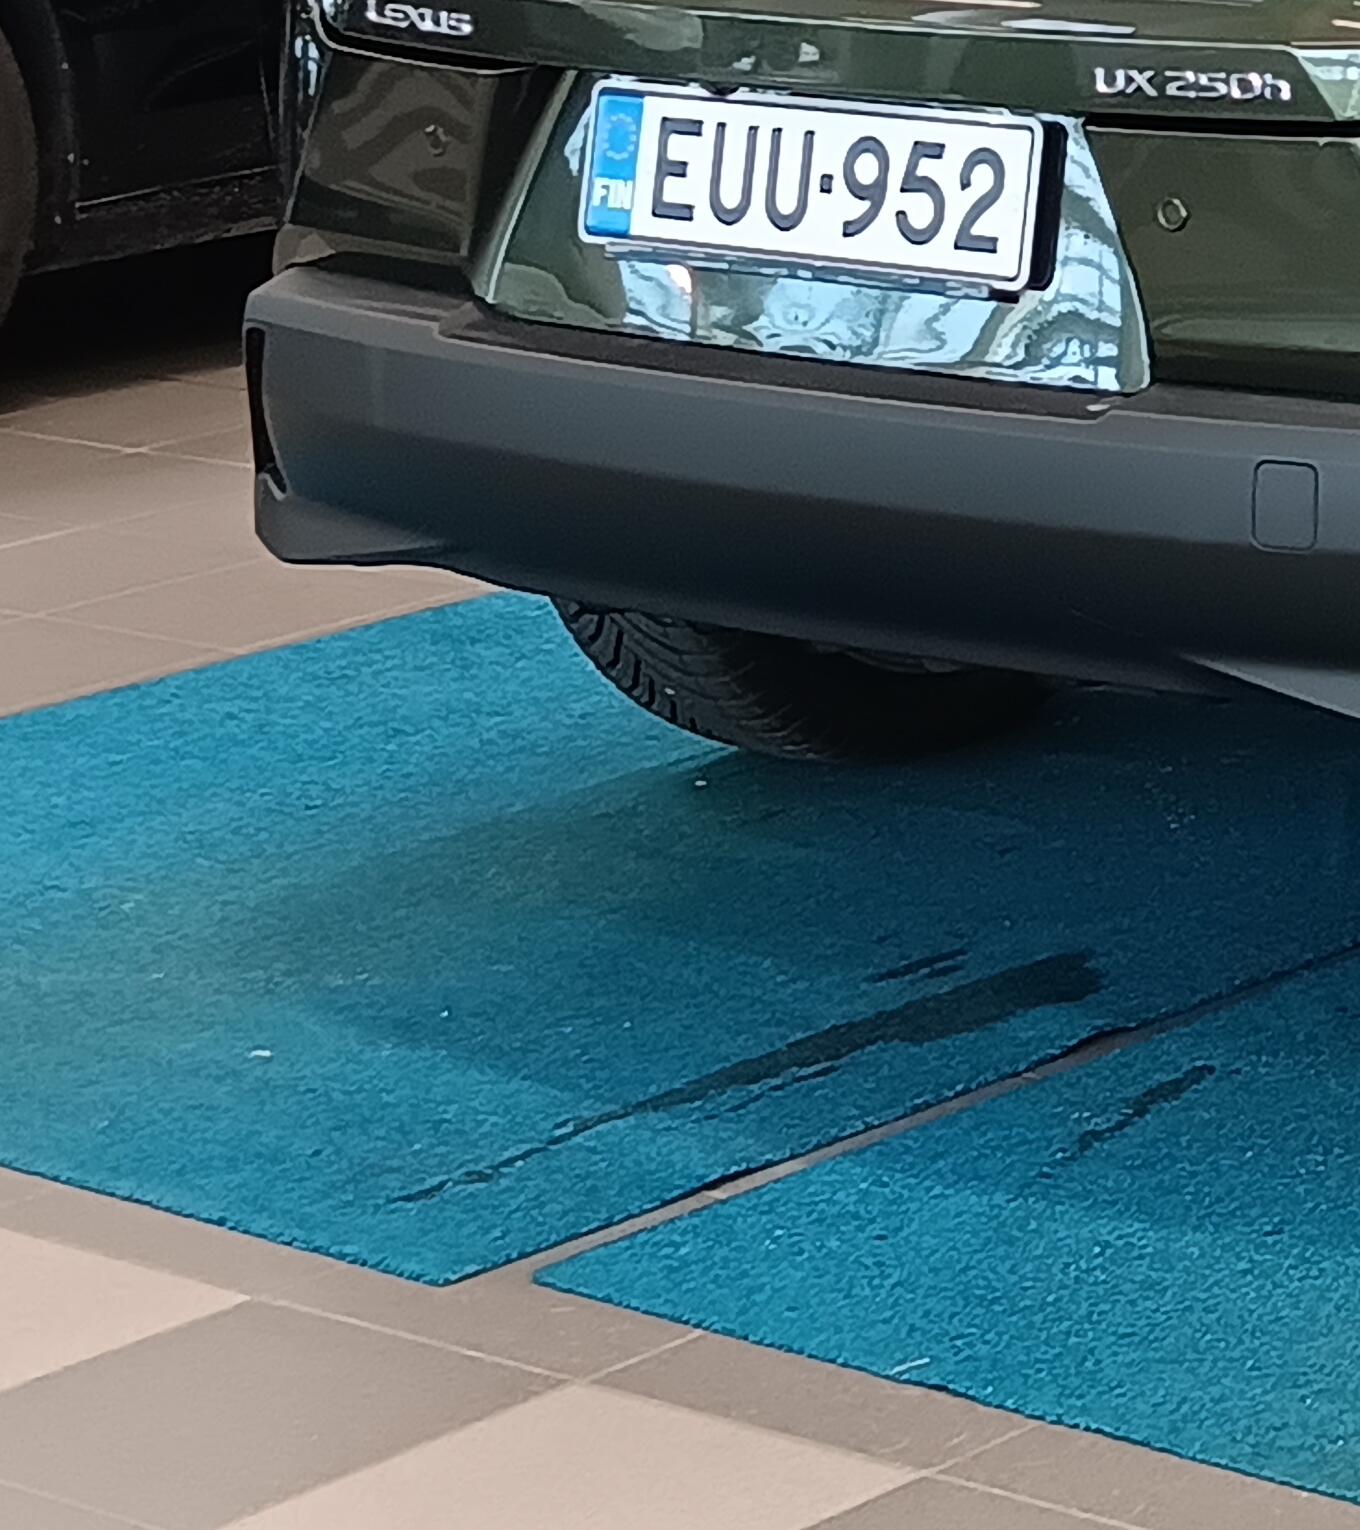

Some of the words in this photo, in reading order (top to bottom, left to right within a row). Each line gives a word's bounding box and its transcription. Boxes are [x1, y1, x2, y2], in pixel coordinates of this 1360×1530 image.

[1094, 67, 1159, 97] UX
[1163, 70, 1292, 101] 250h
[592, 177, 635, 211] FIN
